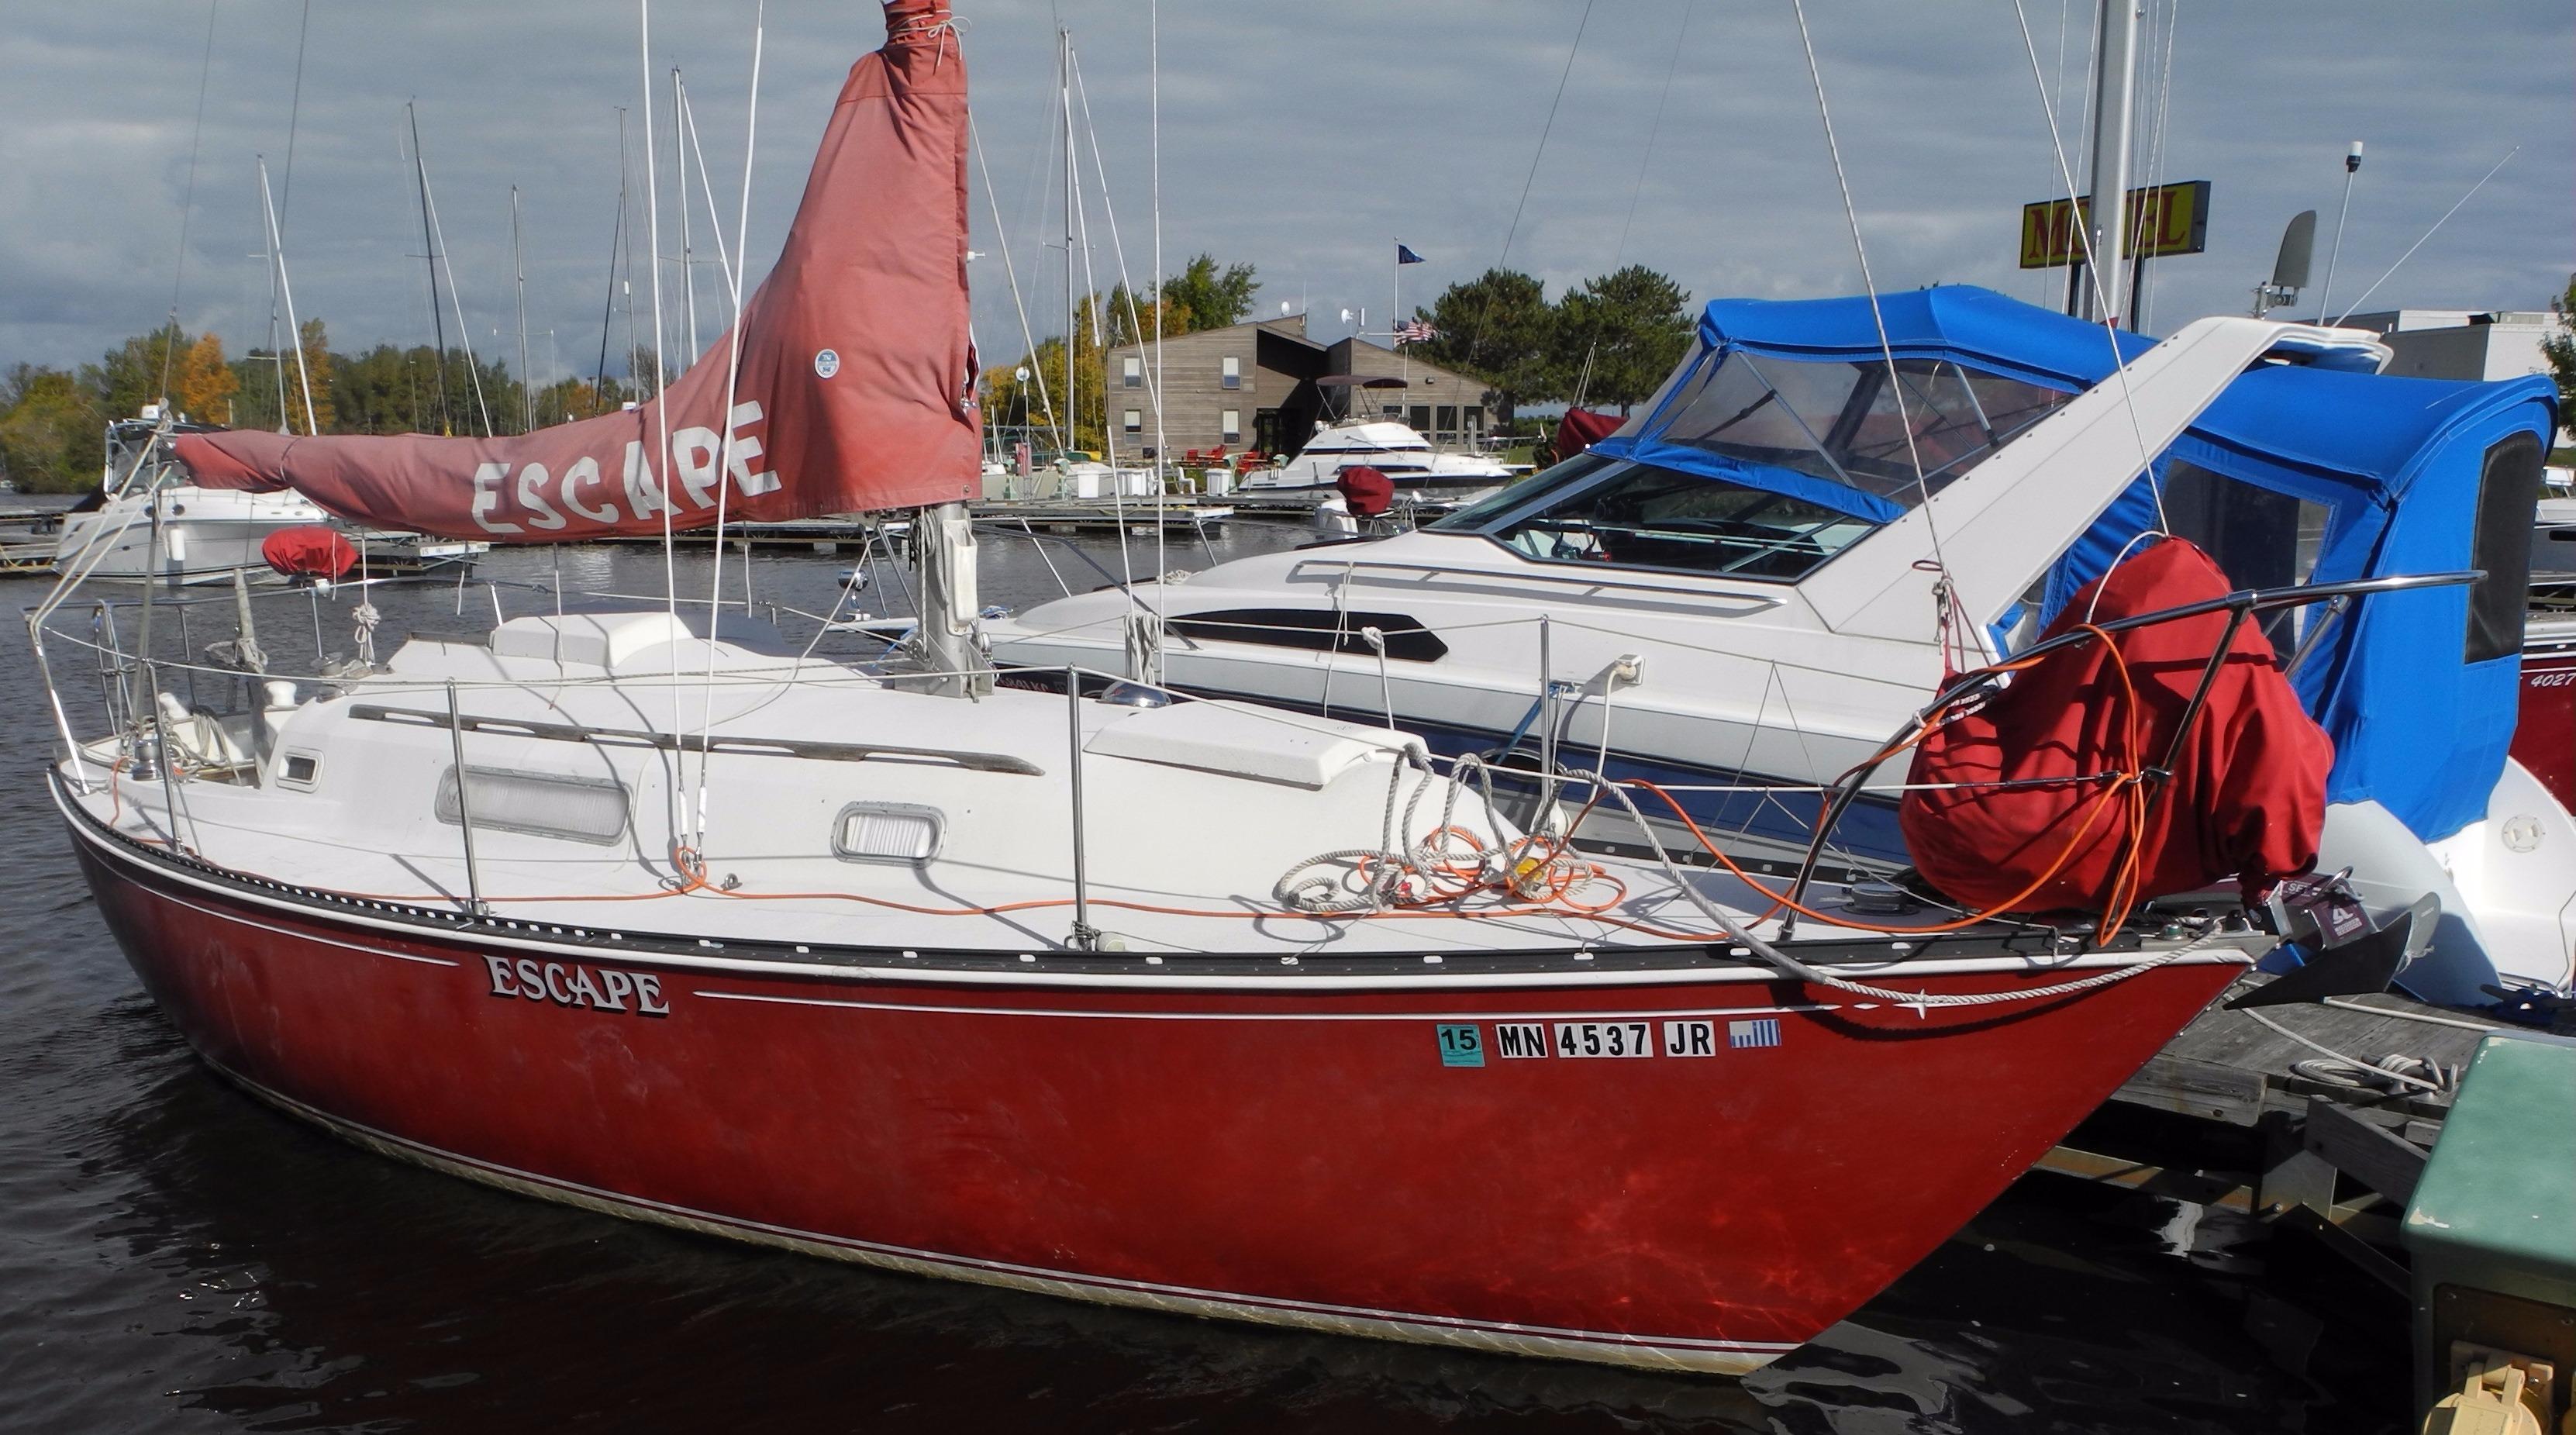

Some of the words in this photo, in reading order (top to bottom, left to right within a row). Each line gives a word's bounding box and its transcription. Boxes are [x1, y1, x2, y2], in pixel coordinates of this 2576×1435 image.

[471, 400, 782, 534] ESCAPE
[482, 955, 671, 1017] ESCAPE
[1441, 1028, 1477, 1050] 15
[1498, 1026, 1546, 1057] MN
[1560, 1024, 1647, 1056] 4537
[1670, 1023, 1711, 1055] JR
